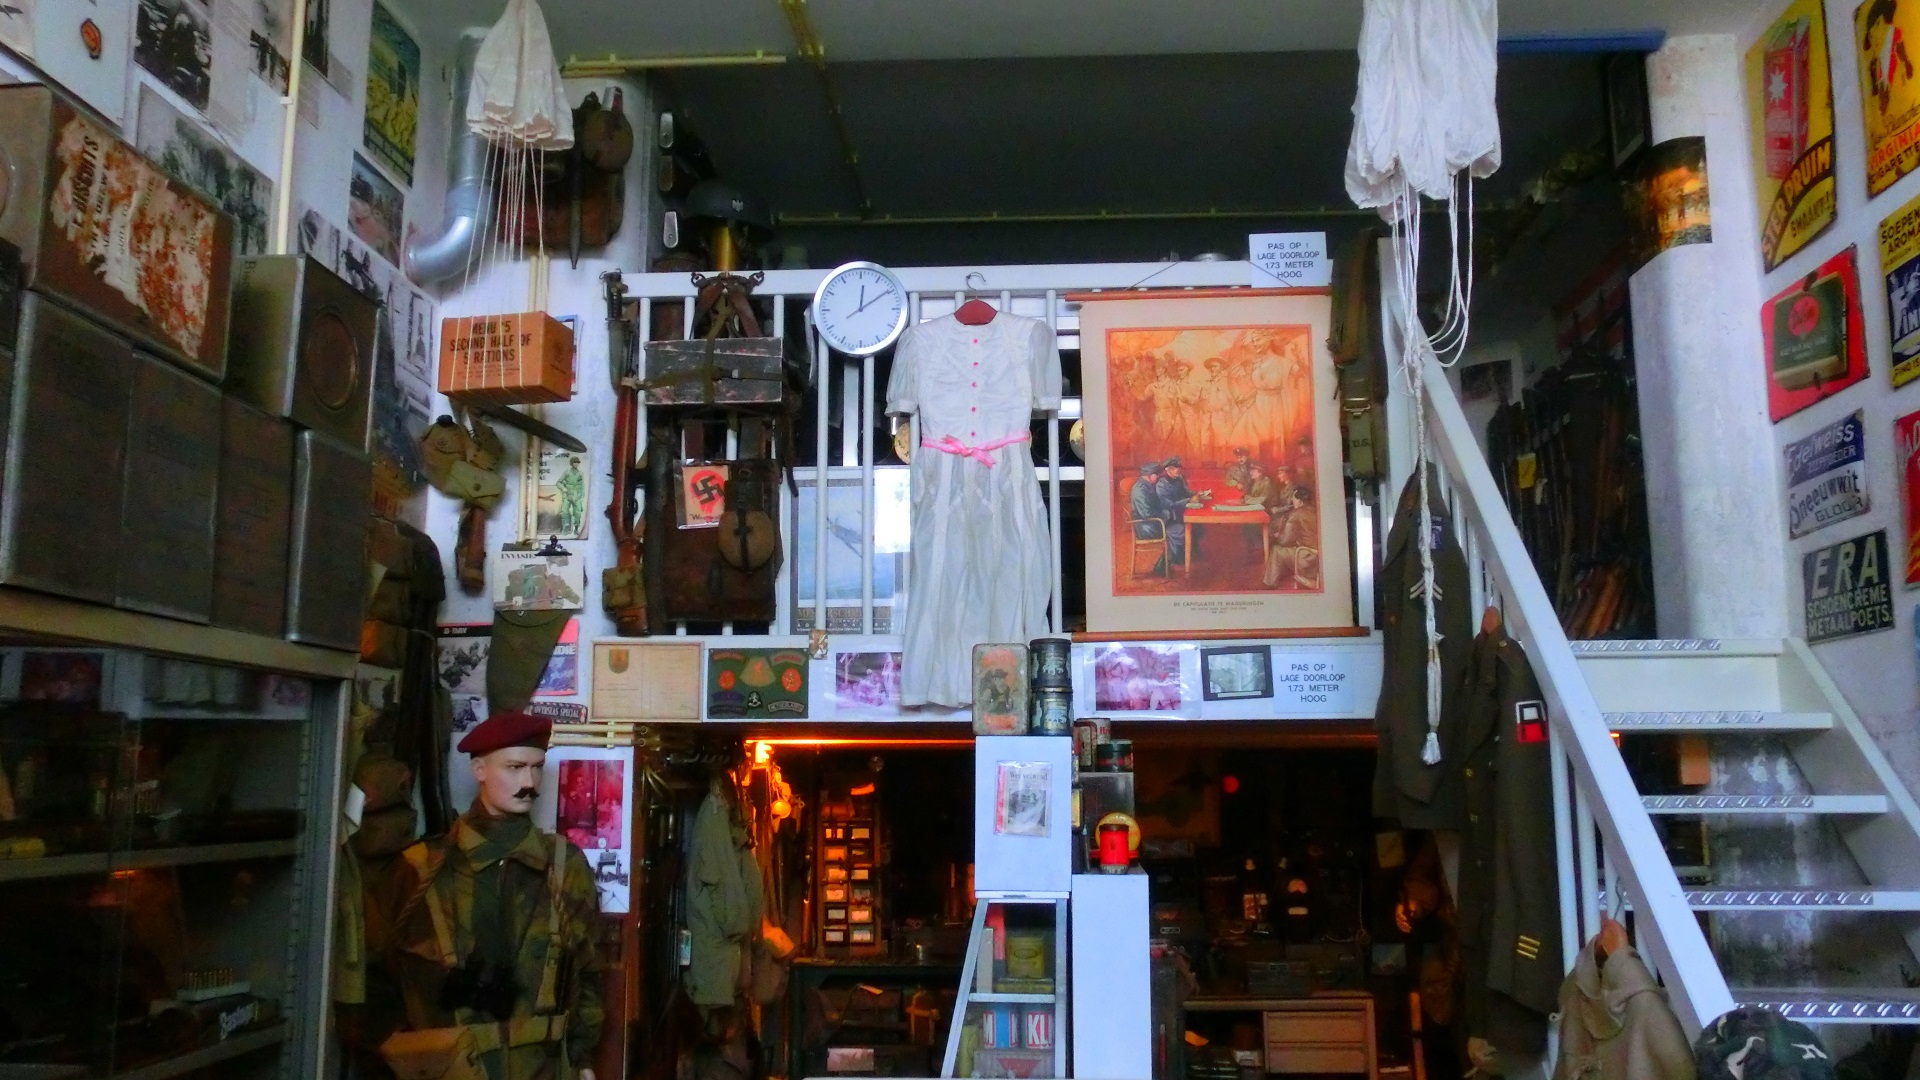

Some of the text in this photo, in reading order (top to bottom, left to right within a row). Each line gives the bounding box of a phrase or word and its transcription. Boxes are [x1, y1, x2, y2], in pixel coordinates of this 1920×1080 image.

[1783, 140, 1831, 207] PRUIM
[1257, 251, 1320, 260] LAGE DOORLOOP
[1285, 260, 1314, 268] METER
[1277, 270, 1303, 278] HOOG
[473, 321, 497, 335] MENU
[450, 333, 532, 352] SECOND HALF OF
[473, 348, 516, 364] RATIONS
[1787, 423, 1855, 478] Edelweiss
[1790, 469, 1861, 530] Sneeuwwit
[1811, 535, 1880, 601] ERA
[1806, 583, 1889, 620] SCHOENCREME
[1291, 663, 1309, 671] PAS
[1313, 663, 1327, 671] OP
[1280, 673, 1346, 682] LAGE DOORLOOP
[1309, 684, 1339, 692] METER
[1300, 694, 1327, 703] HOOG
